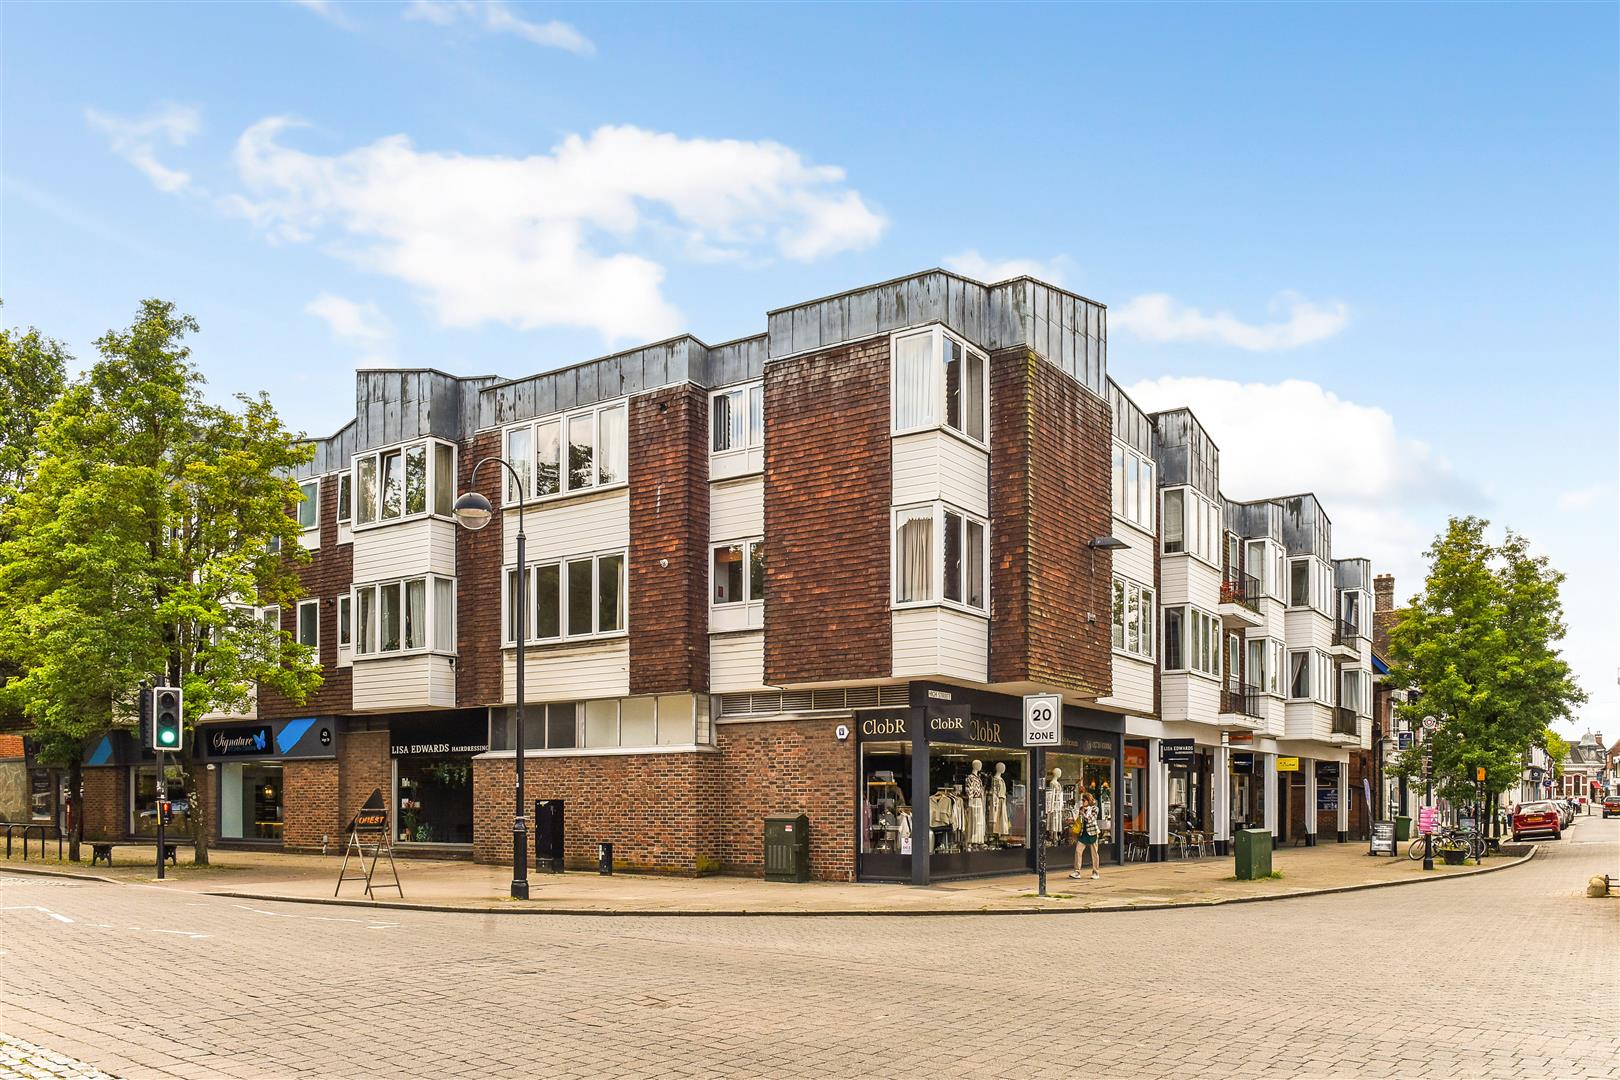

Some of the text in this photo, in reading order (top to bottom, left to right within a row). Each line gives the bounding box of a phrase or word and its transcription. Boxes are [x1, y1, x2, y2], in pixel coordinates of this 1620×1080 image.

[1033, 708, 1052, 721] 20
[862, 718, 907, 735] ClobR
[930, 717, 964, 730] ClobR
[969, 719, 1002, 743] ClobR
[1029, 731, 1054, 740] ZONE
[212, 730, 254, 755] Signature
[391, 743, 489, 754] LISA EDWARDS HAIRDRESSING
